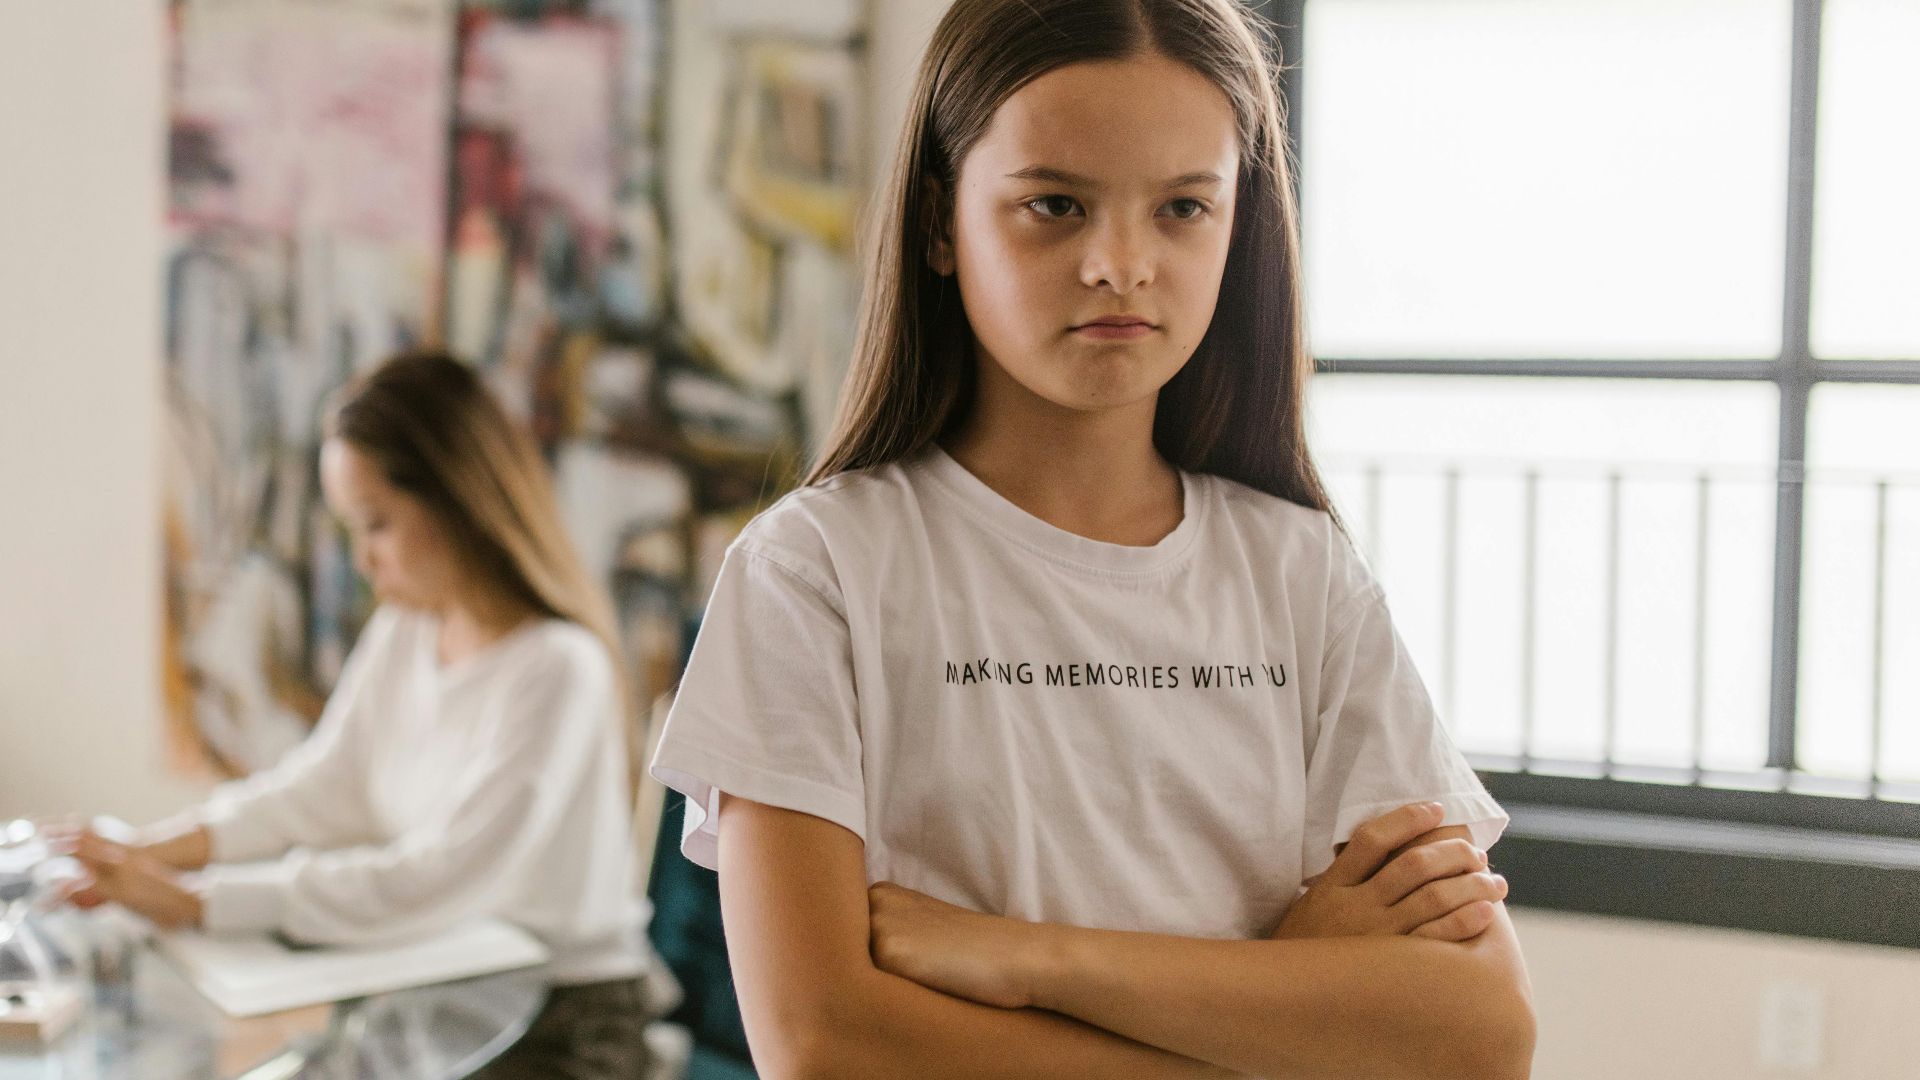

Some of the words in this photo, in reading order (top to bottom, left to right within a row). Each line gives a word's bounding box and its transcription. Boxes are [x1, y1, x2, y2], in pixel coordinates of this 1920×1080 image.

[946, 657, 1033, 685] MAKING
[1045, 663, 1179, 689] MEMORIES
[1191, 665, 1254, 689] WITH
